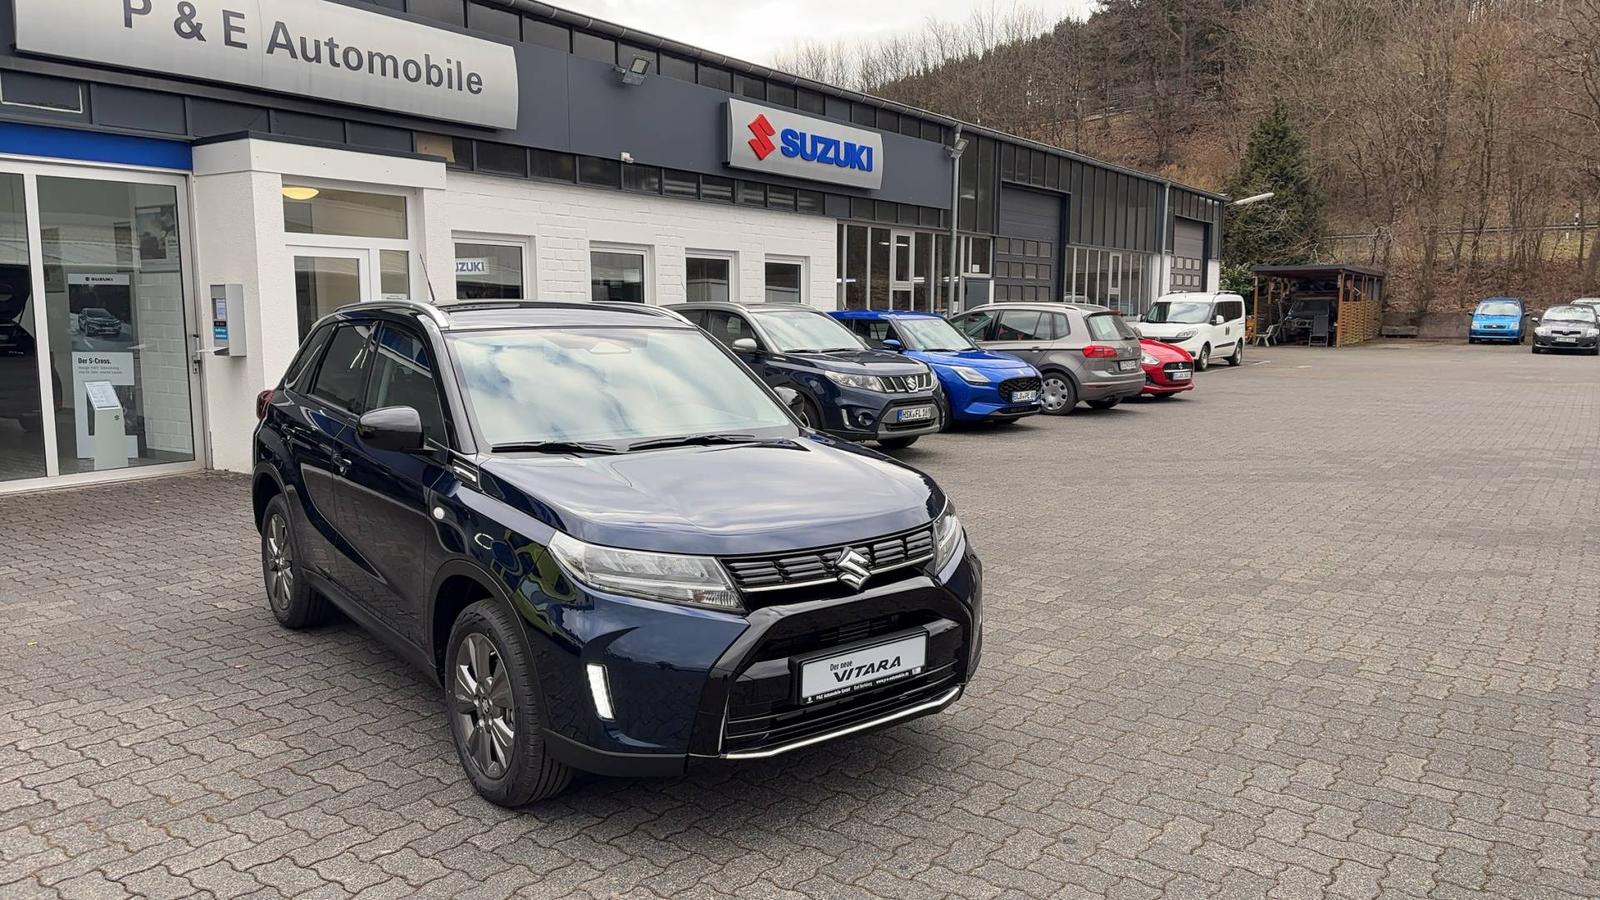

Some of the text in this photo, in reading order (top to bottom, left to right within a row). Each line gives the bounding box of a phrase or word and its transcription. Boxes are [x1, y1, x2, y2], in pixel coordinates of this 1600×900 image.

[123, 0, 483, 94] P & E Automobile
[780, 129, 873, 172] SUZUKI
[830, 660, 853, 672] Der neue
[834, 656, 901, 682] VITARA
